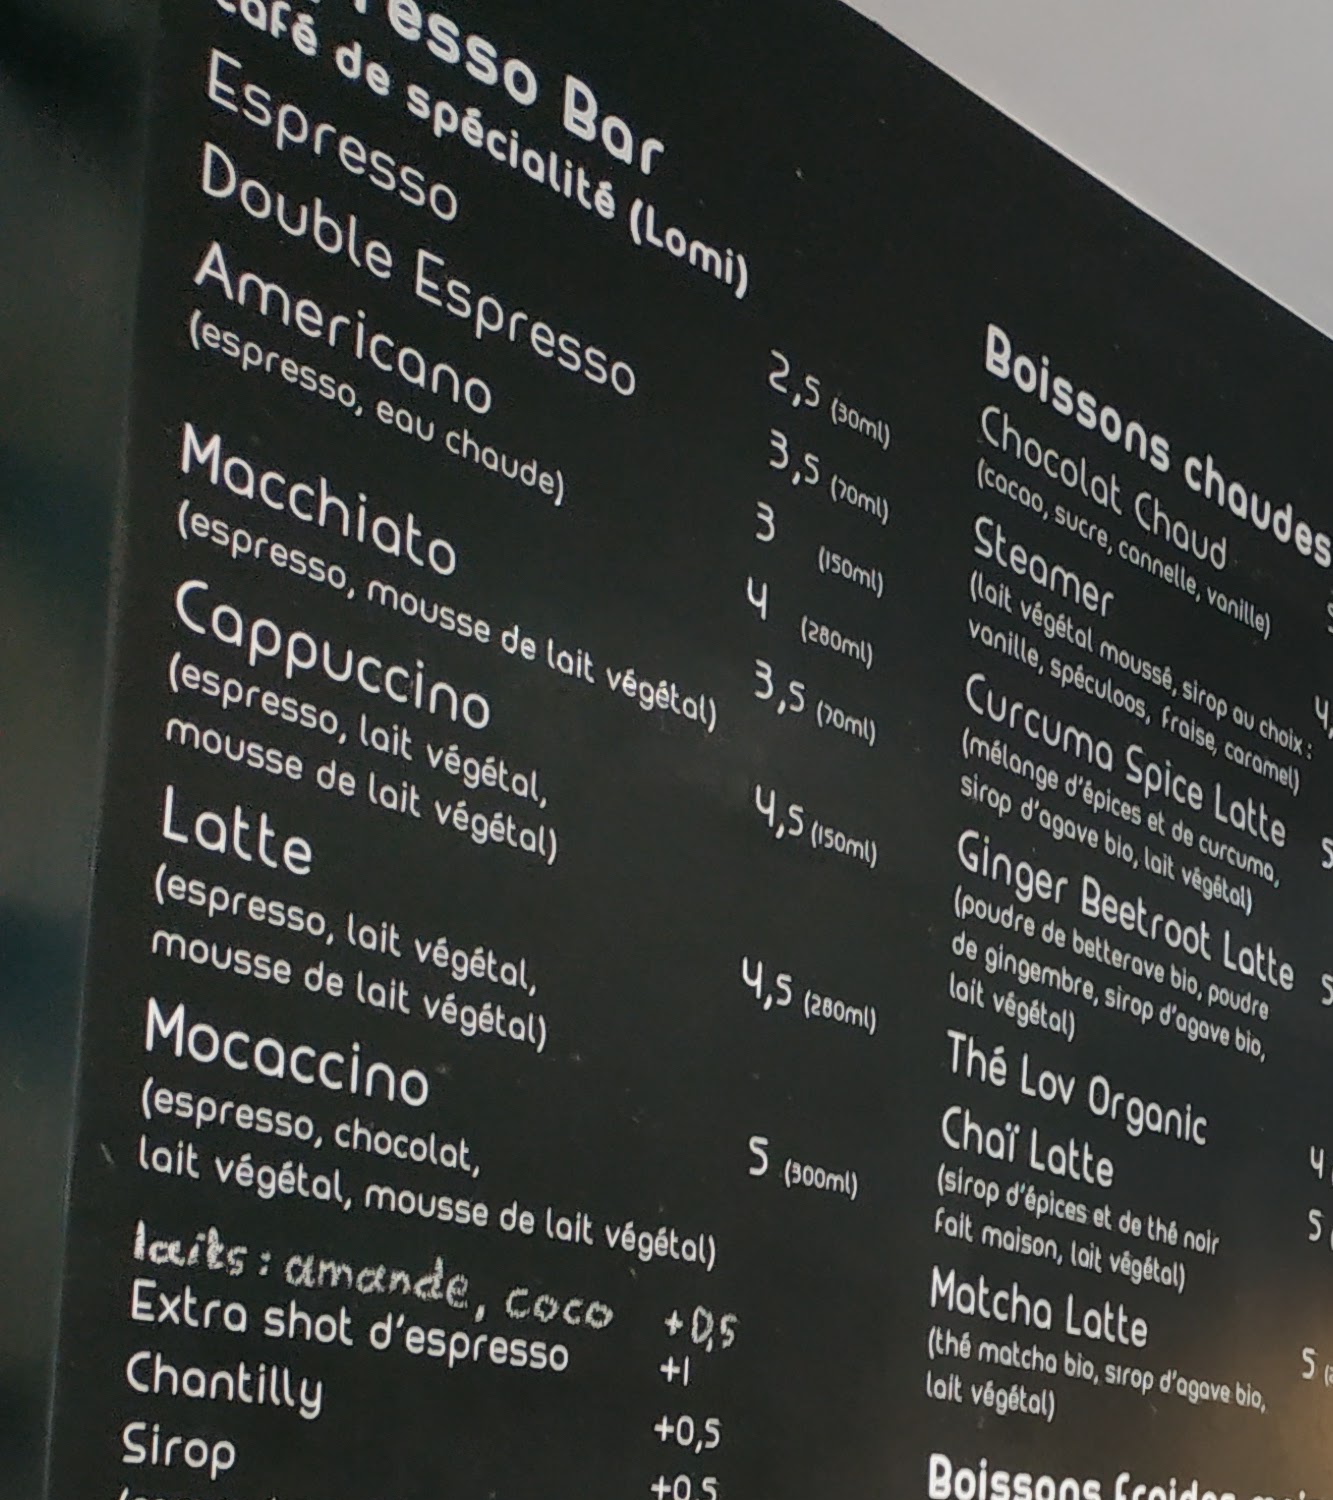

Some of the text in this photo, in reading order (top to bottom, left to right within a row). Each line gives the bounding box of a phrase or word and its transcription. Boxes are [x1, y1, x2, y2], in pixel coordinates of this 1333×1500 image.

[208, 48, 457, 221] Espresso
[335, 41, 748, 299] de spécialité (Lomi)
[563, 84, 665, 176] Bar
[202, 142, 635, 396] Double Espresso
[194, 241, 491, 414] Americano
[190, 309, 564, 506] (espresso, eau chaude)
[769, 349, 890, 450] 2,5 (30ml)
[985, 324, 1331, 567] Boissons chaudes
[181, 422, 456, 575] Macchiato
[981, 406, 1226, 570] Chocolat Chaud
[756, 501, 883, 598] 3 (150ml)
[974, 516, 1114, 617] Steamer
[977, 457, 1270, 640] (cacao, sucre, cannelle, vanille)
[176, 580, 489, 729] Cappuccino
[747, 576, 873, 670] 4 (280ml)
[966, 673, 1285, 847] Curcuma Spice Latte
[163, 785, 312, 875] Latte
[958, 829, 1294, 990] Ginger Beetroot Latte
[742, 957, 876, 1035] 4,5 (280ml)
[146, 997, 428, 1106] Mocaccino
[947, 1029, 1207, 1145] Thé Lov Organic
[942, 1106, 1113, 1187] Chaï Latte
[131, 1278, 247, 1332] Extra
[264, 1299, 353, 1346] shot
[931, 1265, 1147, 1347] Matcha Latte
[126, 1351, 322, 1419] Chantilly
[654, 1415, 720, 1454] +0,5
[122, 1422, 235, 1480] Sirop
